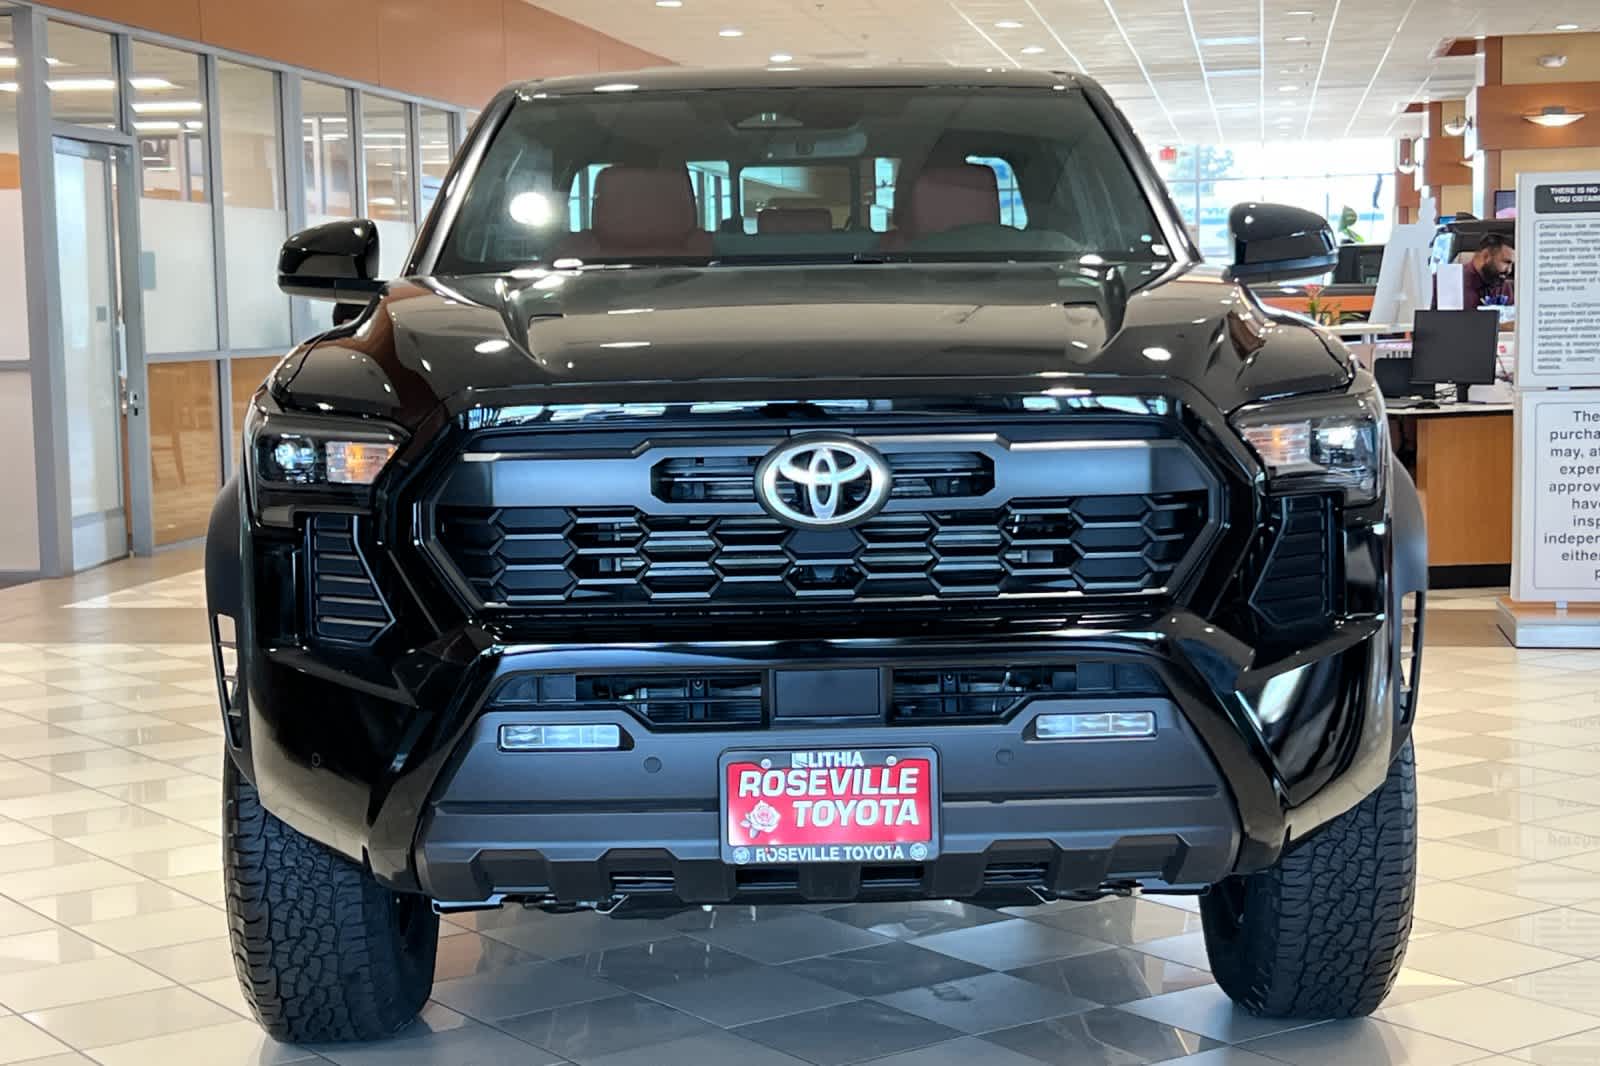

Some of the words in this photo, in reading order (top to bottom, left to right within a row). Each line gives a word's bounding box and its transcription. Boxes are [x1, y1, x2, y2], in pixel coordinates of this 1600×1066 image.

[1586, 186, 1599, 194] NO
[1553, 195, 1570, 203] YOU
[1573, 410, 1600, 422] The
[1550, 429, 1600, 443] purcha
[1550, 447, 1584, 460] may,
[1589, 446, 1600, 457] a
[1549, 483, 1600, 495] approv
[1571, 498, 1600, 510] hav
[1561, 549, 1600, 561] eithe
[808, 751, 865, 768] LITHIA
[738, 768, 919, 797] ROSEVILLE
[792, 799, 919, 827] TOYOTA
[755, 847, 840, 863] ROSEVILLE
[843, 845, 904, 861] TOYOTA
